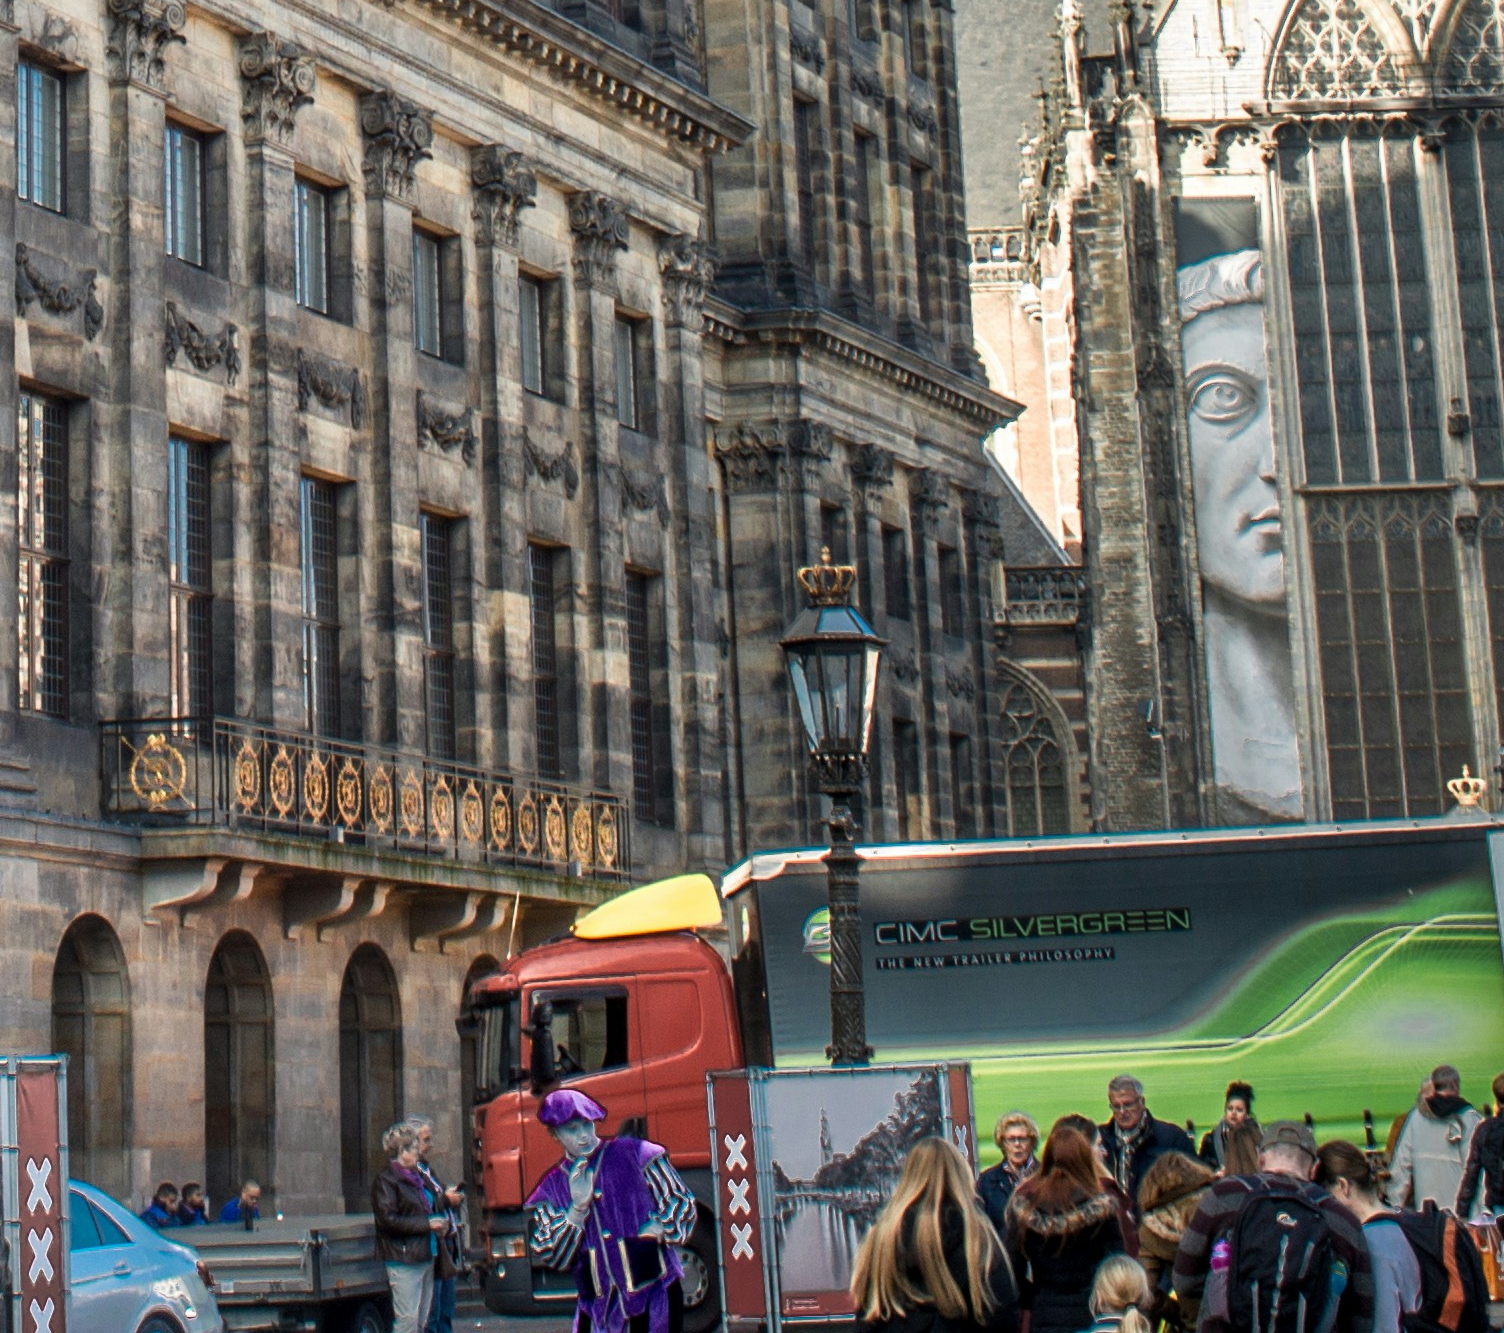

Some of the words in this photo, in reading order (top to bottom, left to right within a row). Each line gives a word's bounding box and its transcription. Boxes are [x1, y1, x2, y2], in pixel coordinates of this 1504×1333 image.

[876, 919, 959, 944] CIMC
[970, 909, 1190, 939] SILVERGREEN
[879, 958, 905, 969] THE
[914, 956, 944, 968] NEW
[953, 953, 1011, 966] TRAILER
[1020, 948, 1112, 962] PHILOSOPHY
